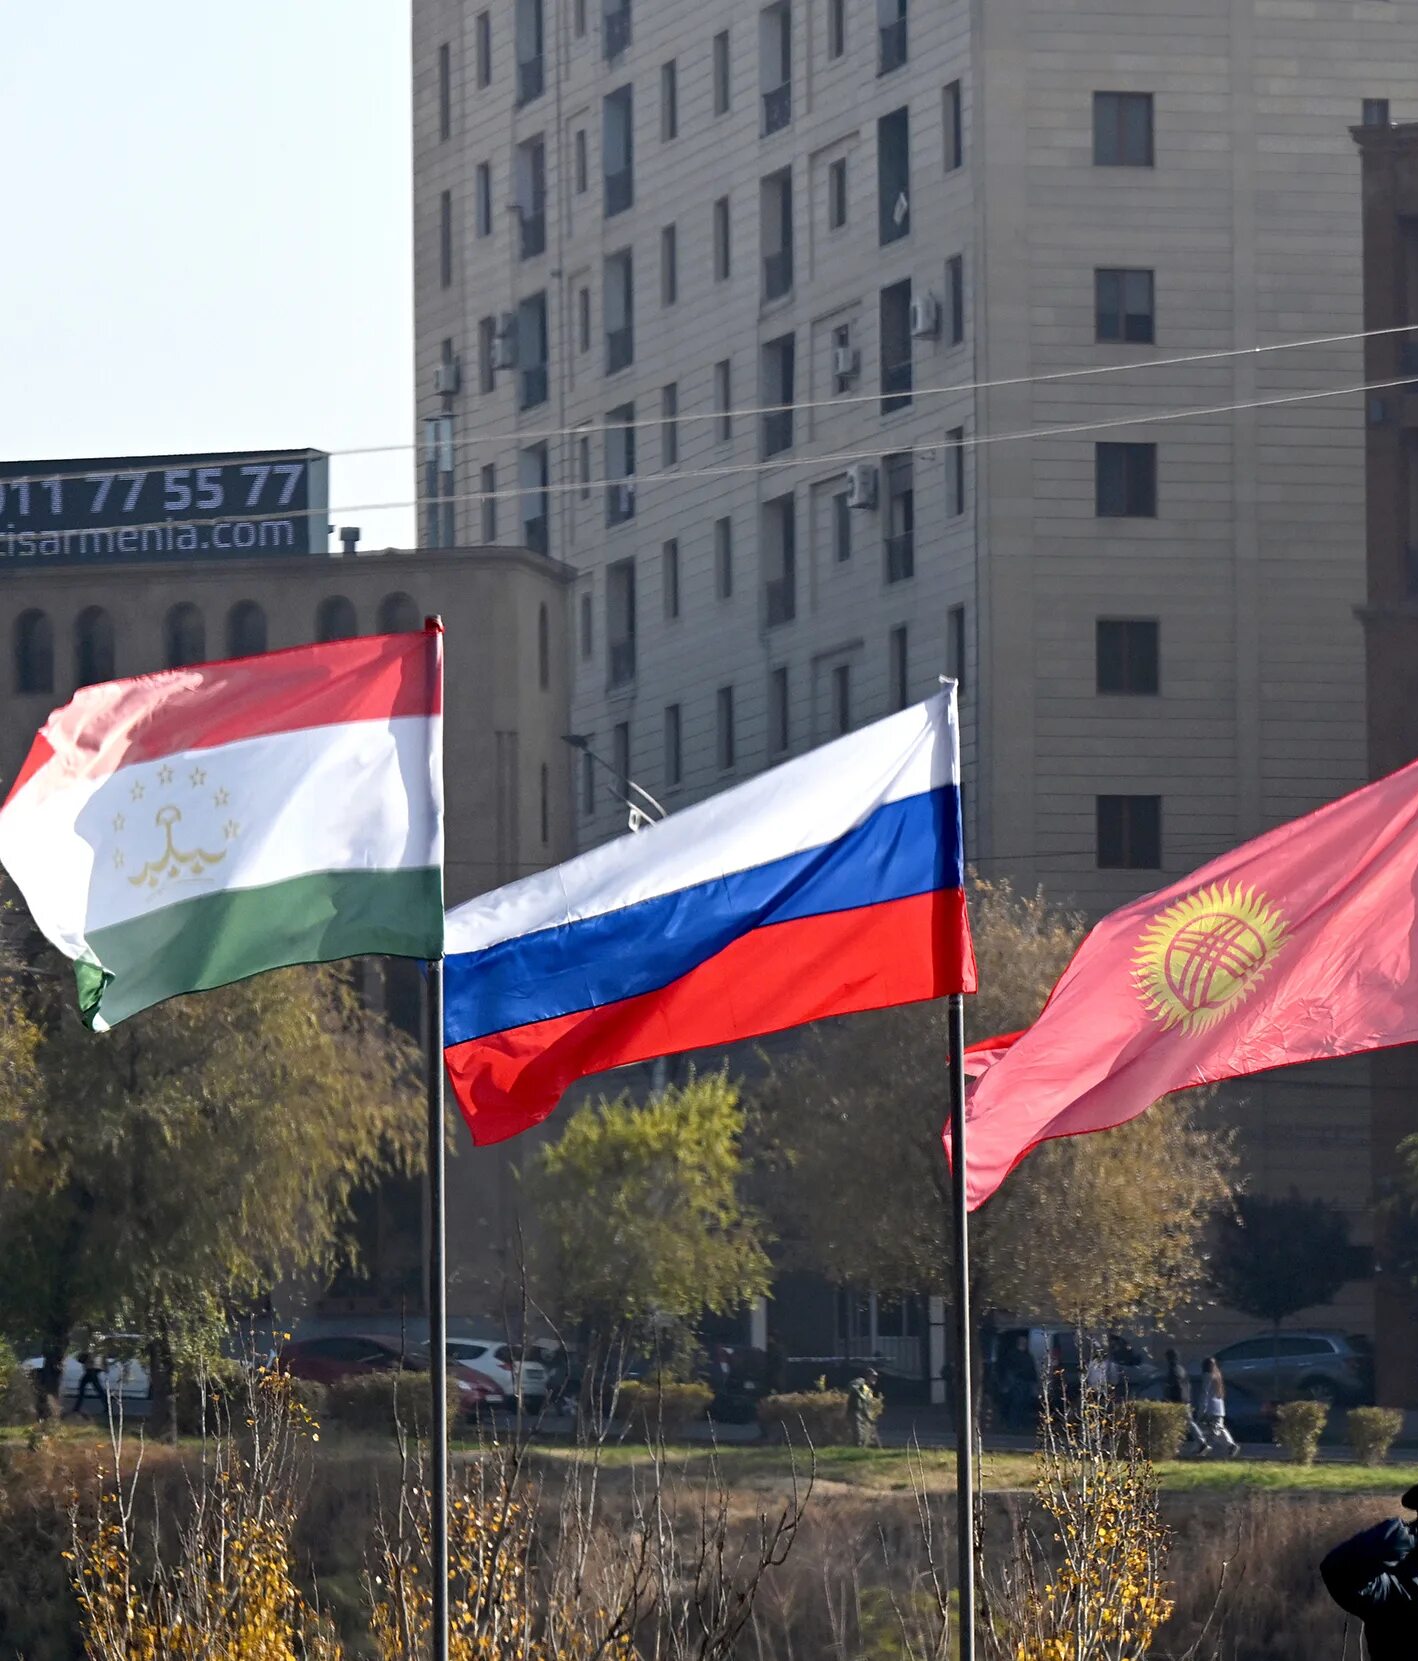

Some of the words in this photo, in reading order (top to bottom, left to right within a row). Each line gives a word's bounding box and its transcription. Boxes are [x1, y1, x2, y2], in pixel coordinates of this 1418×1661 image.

[0, 477, 63, 516] 11
[84, 471, 148, 514] 77
[163, 467, 224, 511] 55
[240, 464, 303, 507] 77
